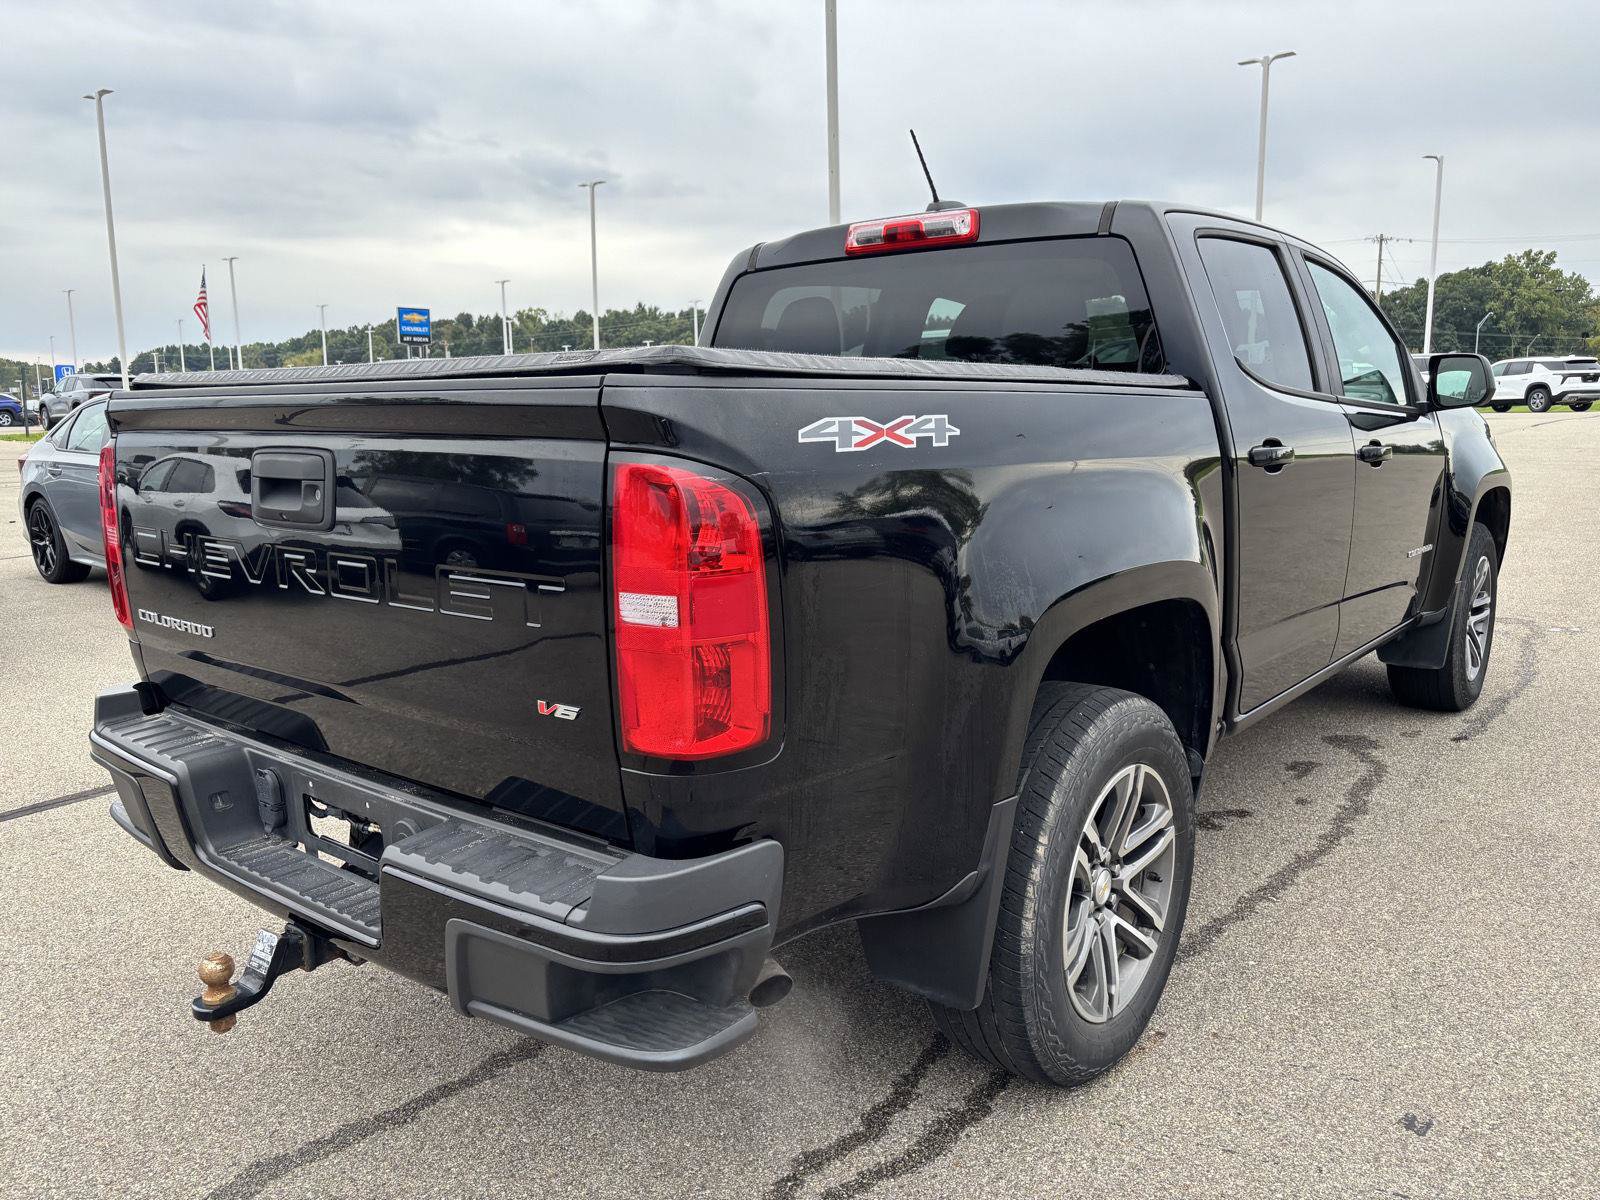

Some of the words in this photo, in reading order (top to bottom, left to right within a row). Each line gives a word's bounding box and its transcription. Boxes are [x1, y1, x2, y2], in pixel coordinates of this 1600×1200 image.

[132, 526, 565, 627] CHEVROLET
[138, 609, 214, 638] COLORADO
[537, 700, 581, 720] V6
